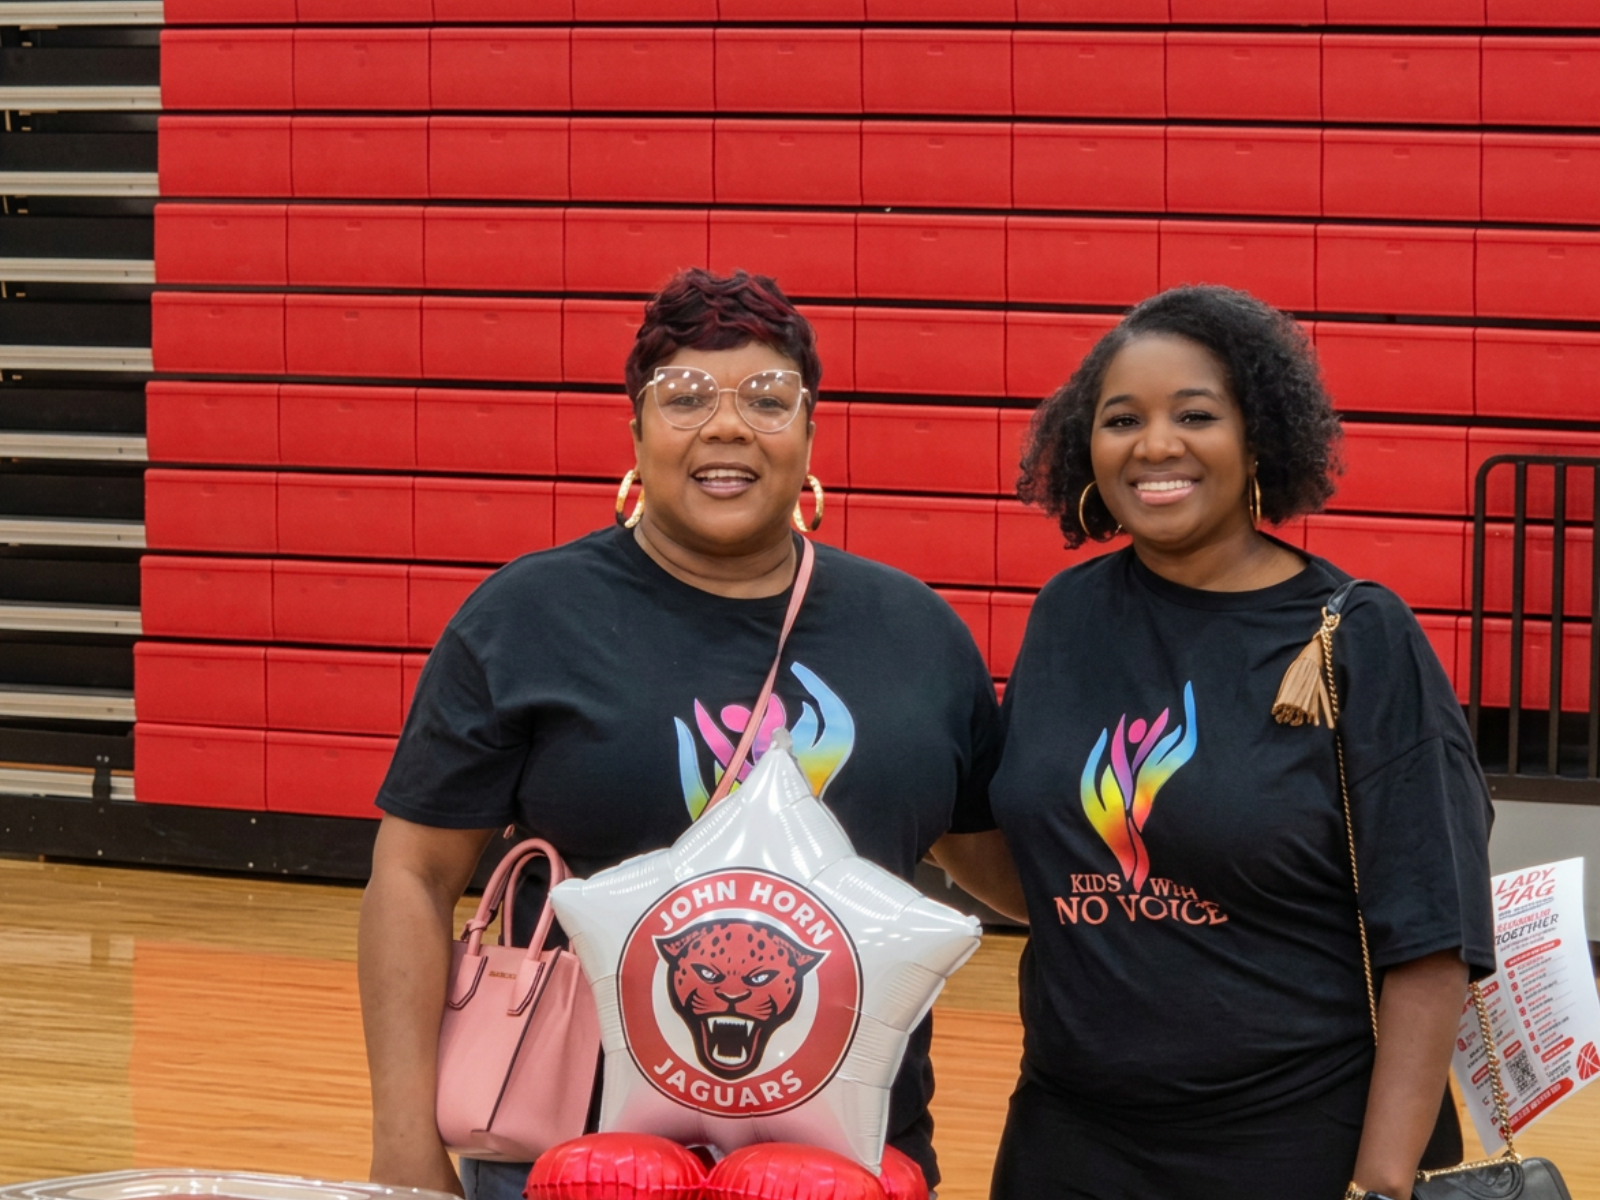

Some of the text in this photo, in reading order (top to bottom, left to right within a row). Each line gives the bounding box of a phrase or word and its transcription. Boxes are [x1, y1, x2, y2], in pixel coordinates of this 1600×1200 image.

[1070, 873, 1122, 893] KIDS
[1494, 867, 1556, 896] LADY
[1498, 879, 1556, 911] JAG
[659, 880, 834, 945] JOHN HORN
[1053, 894, 1229, 925] NO VOICE
[653, 1058, 802, 1107] JAGUARS
